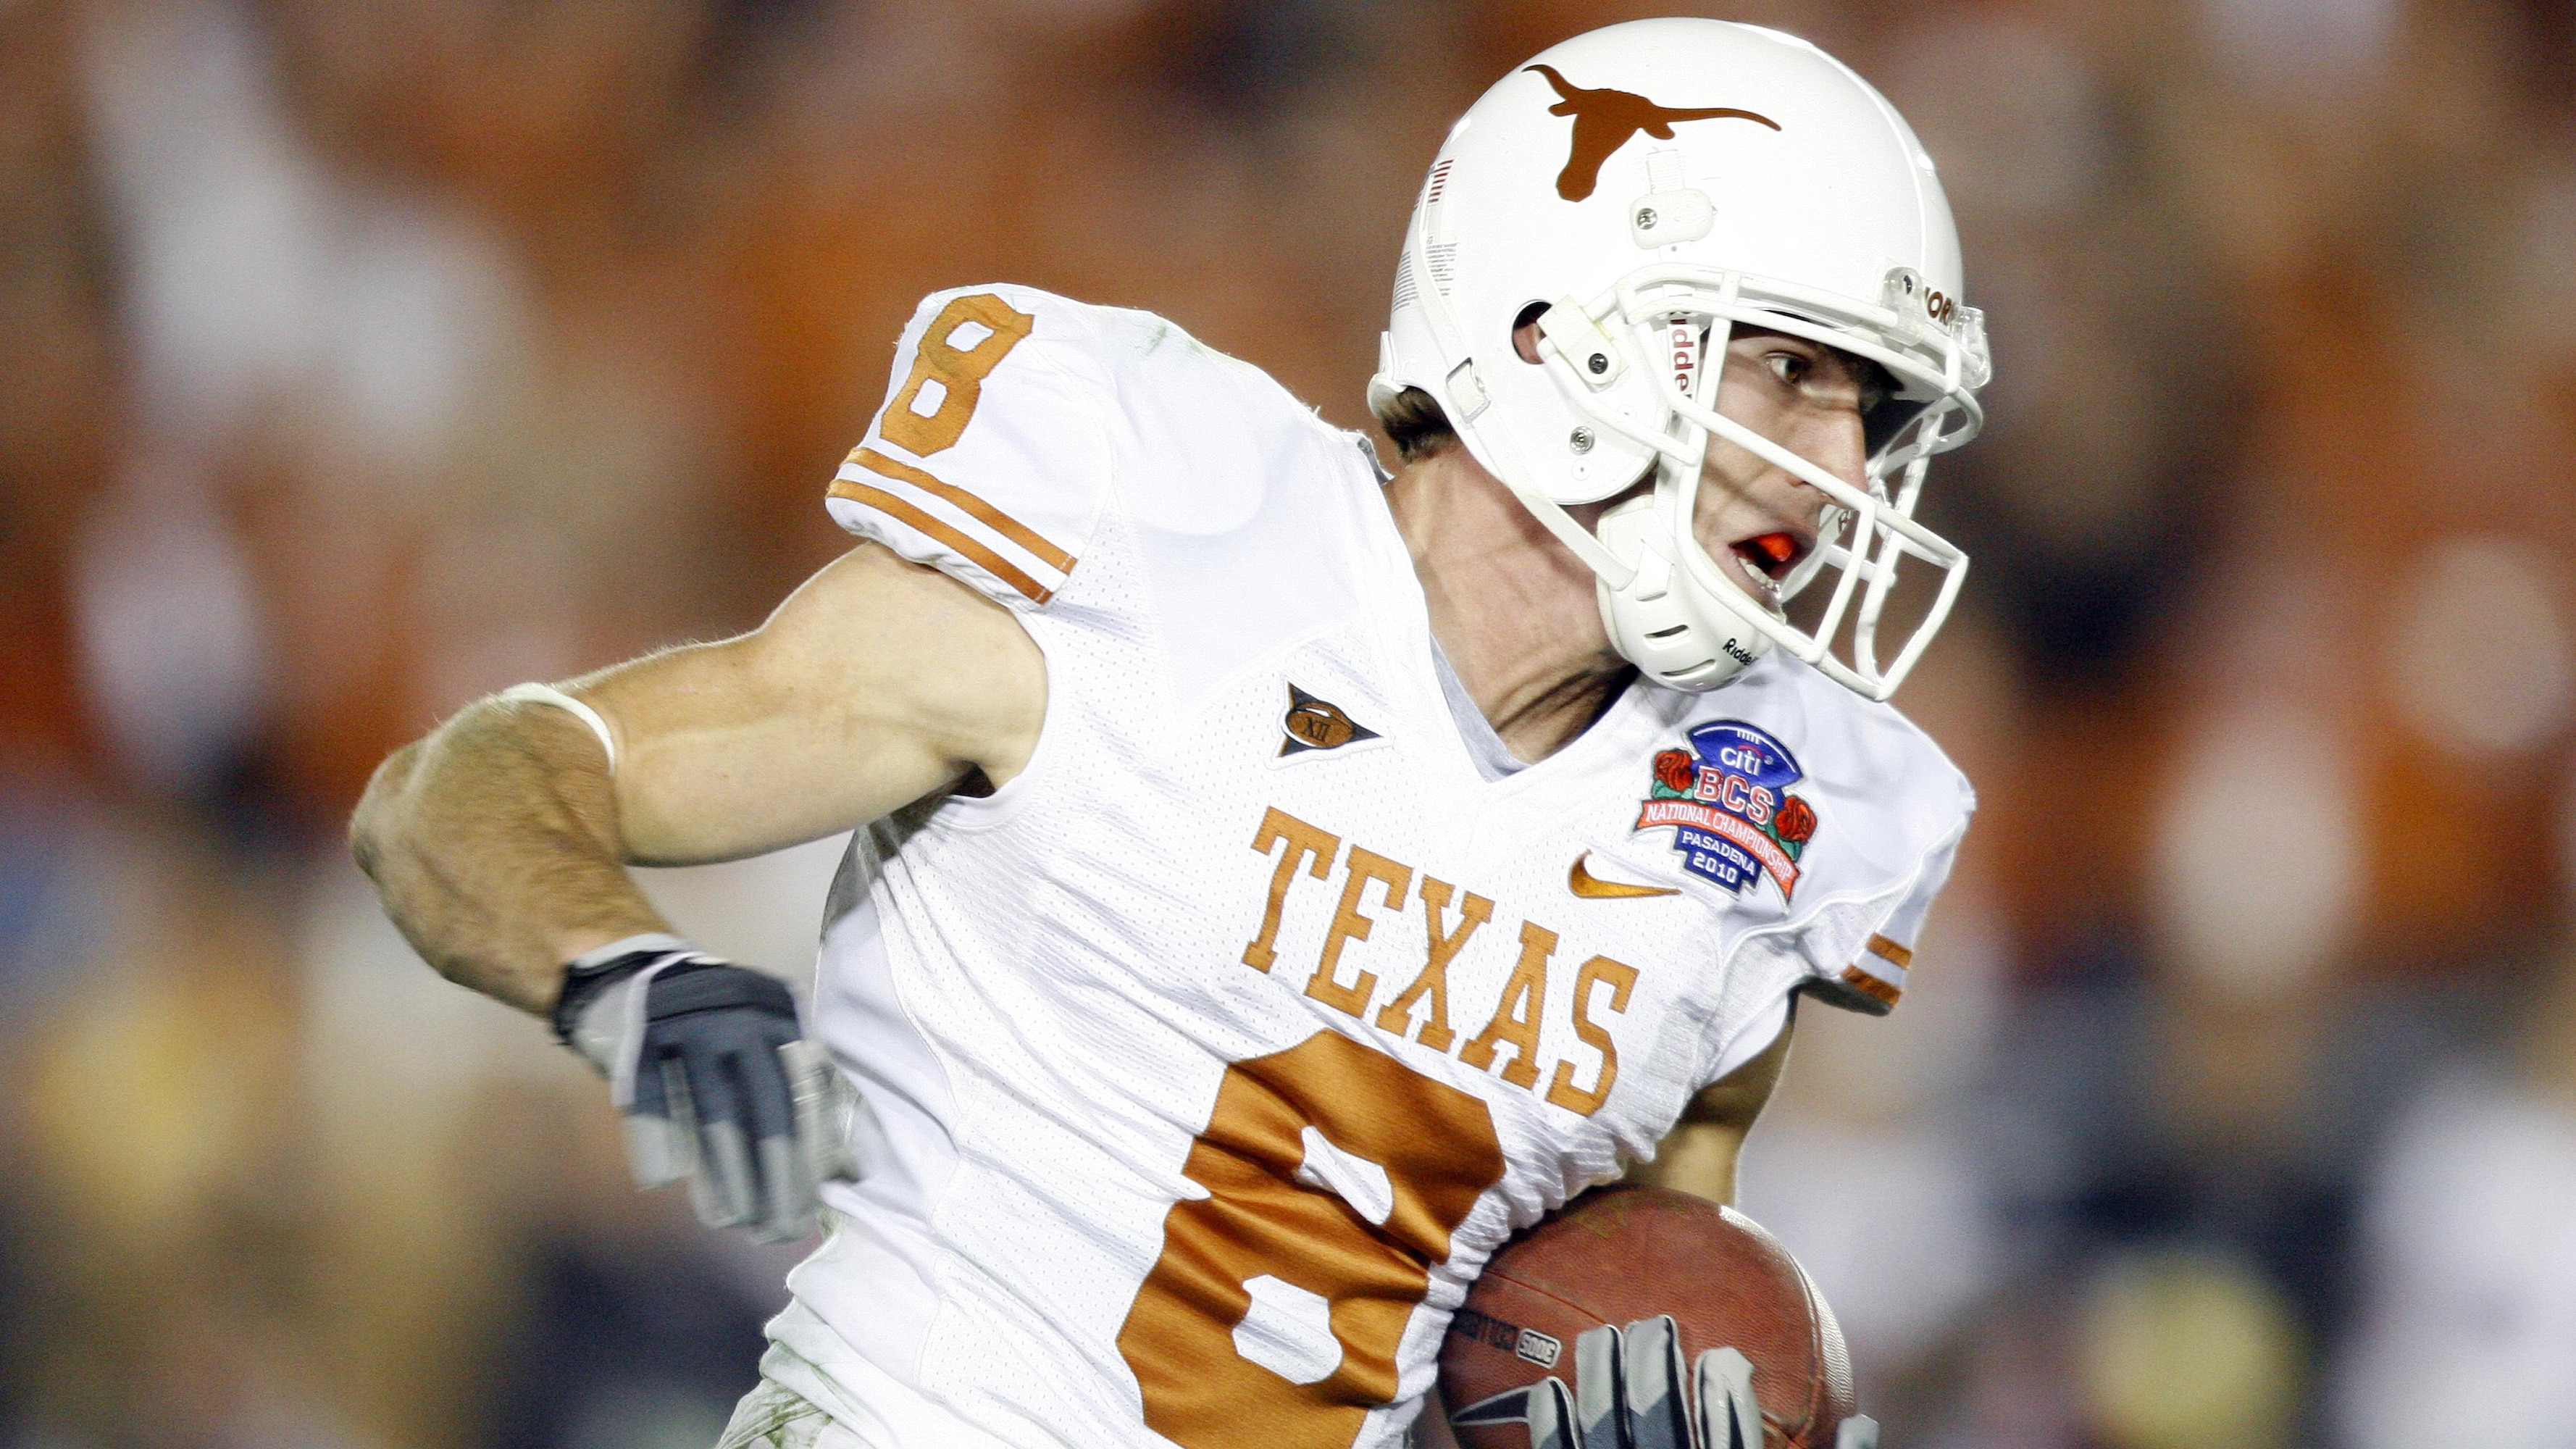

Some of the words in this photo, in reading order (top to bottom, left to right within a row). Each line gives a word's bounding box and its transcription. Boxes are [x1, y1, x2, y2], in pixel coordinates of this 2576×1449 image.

[879, 293, 1034, 458] 8
[1302, 717, 1331, 741] XII
[1720, 747, 1762, 776] citi
[1695, 766, 1773, 824] BCS
[1646, 803, 1711, 827] NATIONAL
[1713, 813, 1794, 882] CHAMPIONSHIP
[1682, 830, 1756, 877] PASADENA
[1693, 851, 1739, 884] 2010
[1241, 805, 1639, 1117] TEXAS
[1116, 1027, 1507, 1449] 8
